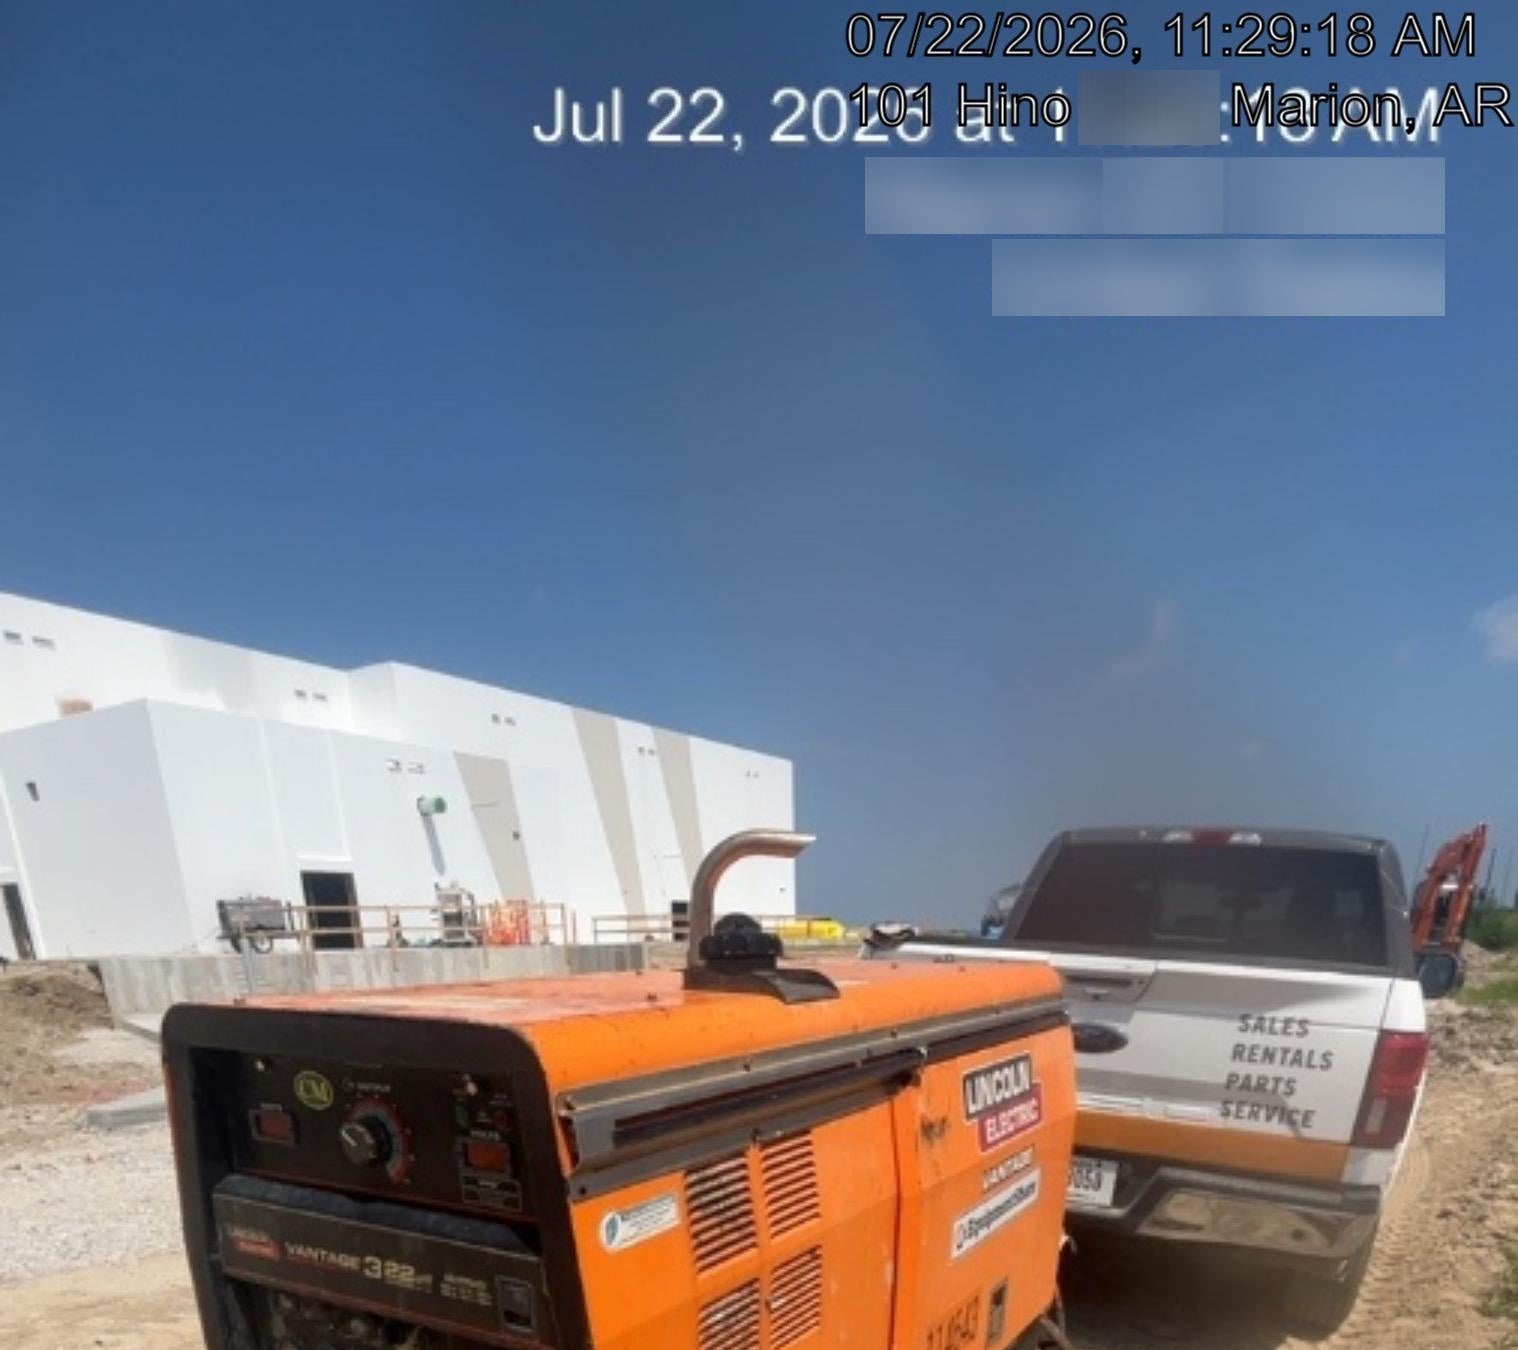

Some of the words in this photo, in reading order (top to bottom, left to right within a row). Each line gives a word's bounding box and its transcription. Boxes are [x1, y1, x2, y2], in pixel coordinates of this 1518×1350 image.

[1238, 1013, 1309, 1038] SALES
[1231, 1043, 1334, 1071] RENTALS
[966, 1060, 1031, 1114] LINCOLN
[1224, 1073, 1297, 1098] PARTS
[984, 1097, 1040, 1145] ELECTRIC
[1219, 1100, 1316, 1129] SERVICE
[284, 1241, 361, 1270] VANTAGE
